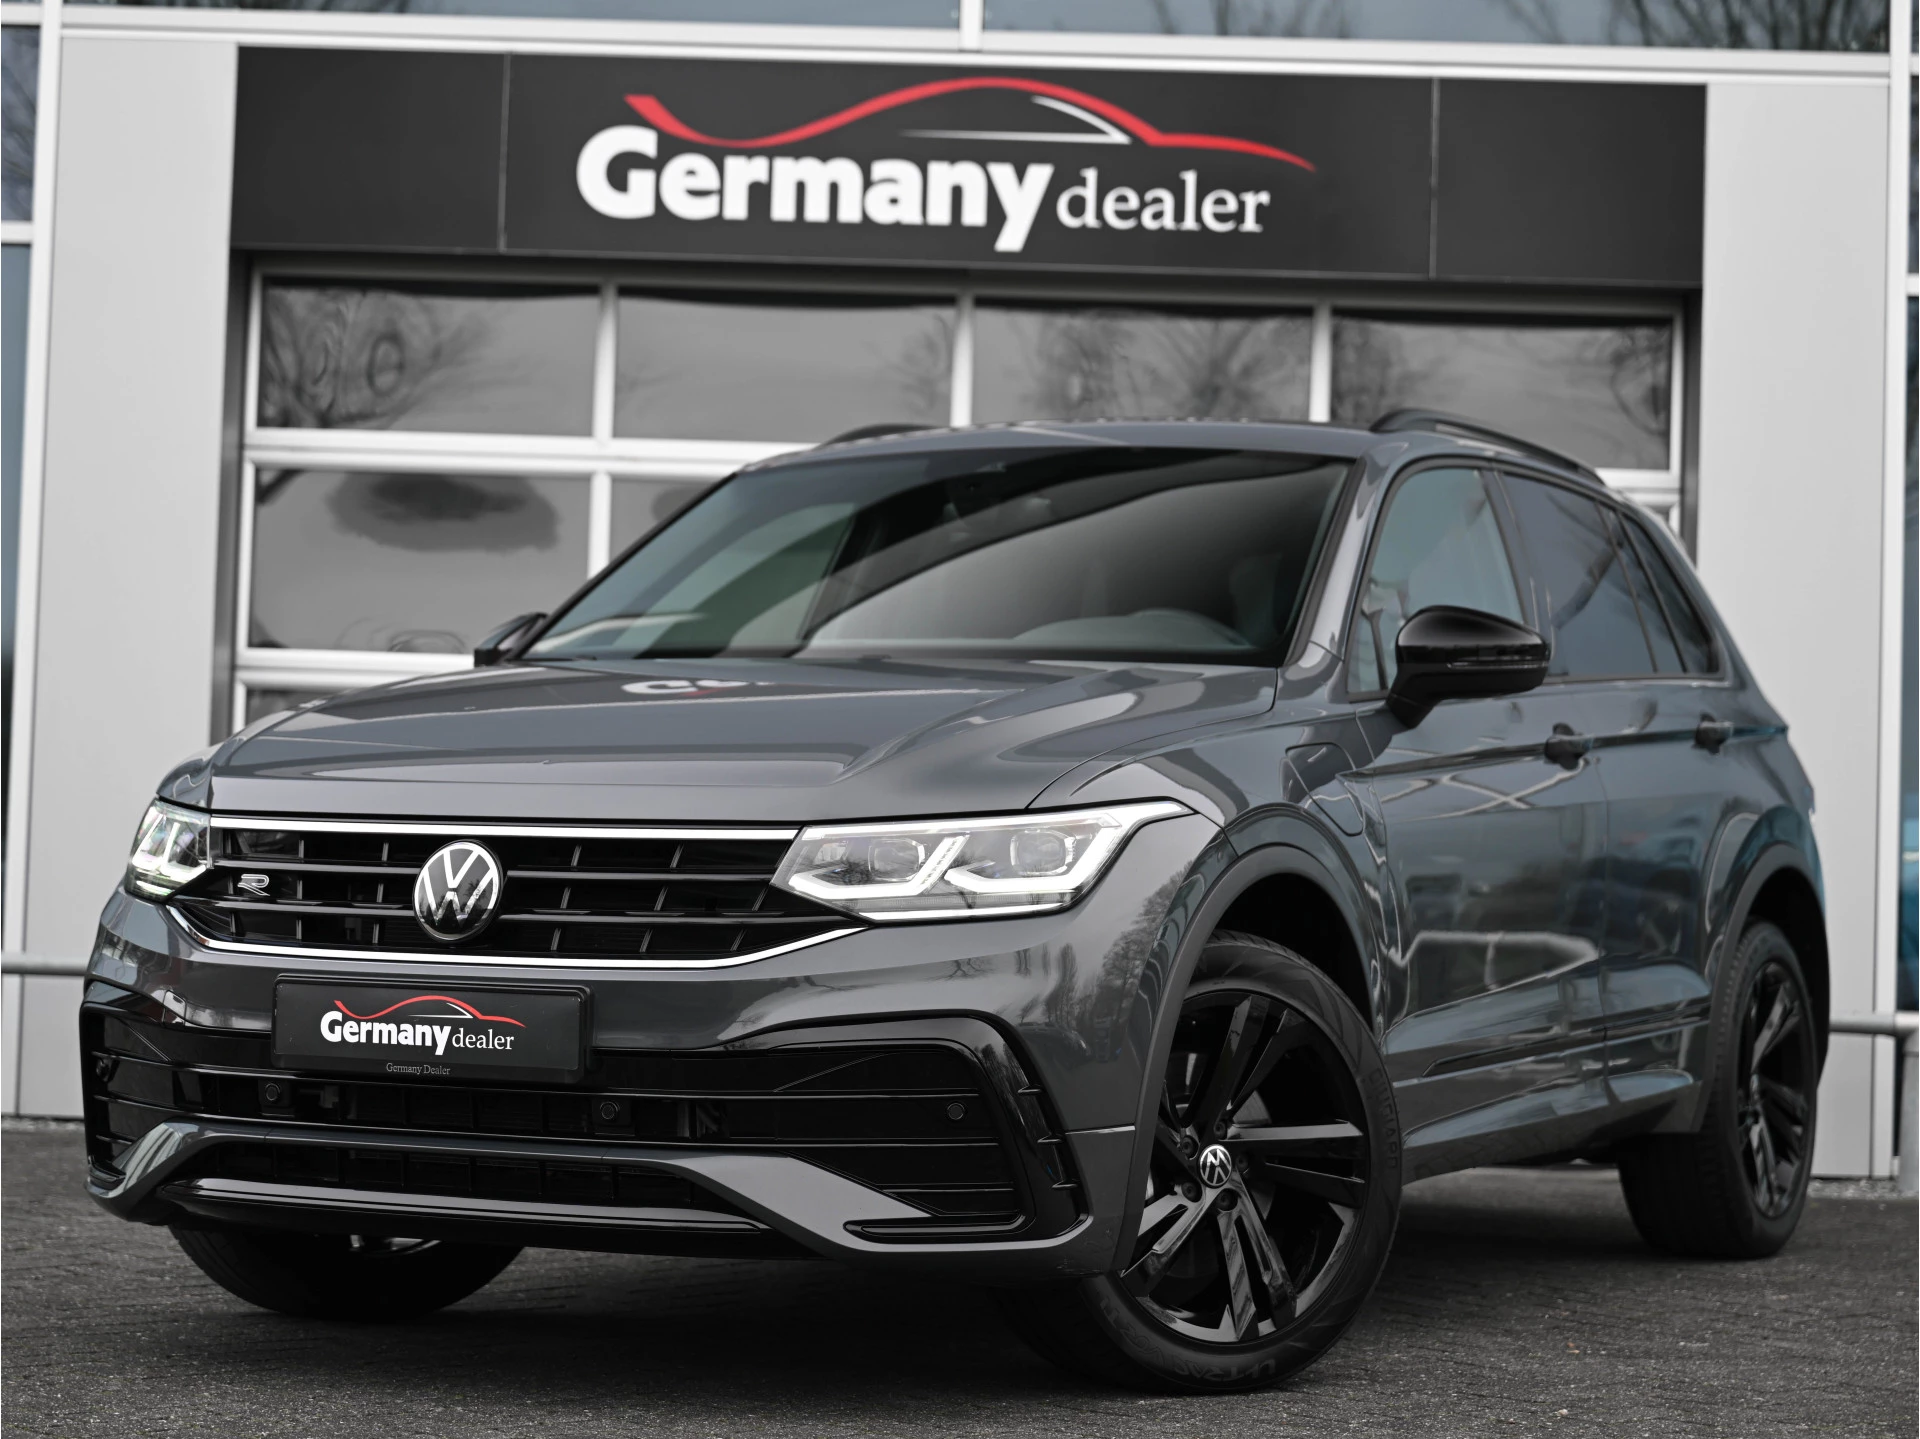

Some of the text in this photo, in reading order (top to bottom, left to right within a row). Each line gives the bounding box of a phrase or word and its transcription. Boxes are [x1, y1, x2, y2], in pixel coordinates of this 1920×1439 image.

[576, 124, 1271, 252] Germany dealer
[320, 1011, 514, 1056] Germany dealer
[386, 1062, 451, 1075] Germany Dealer
